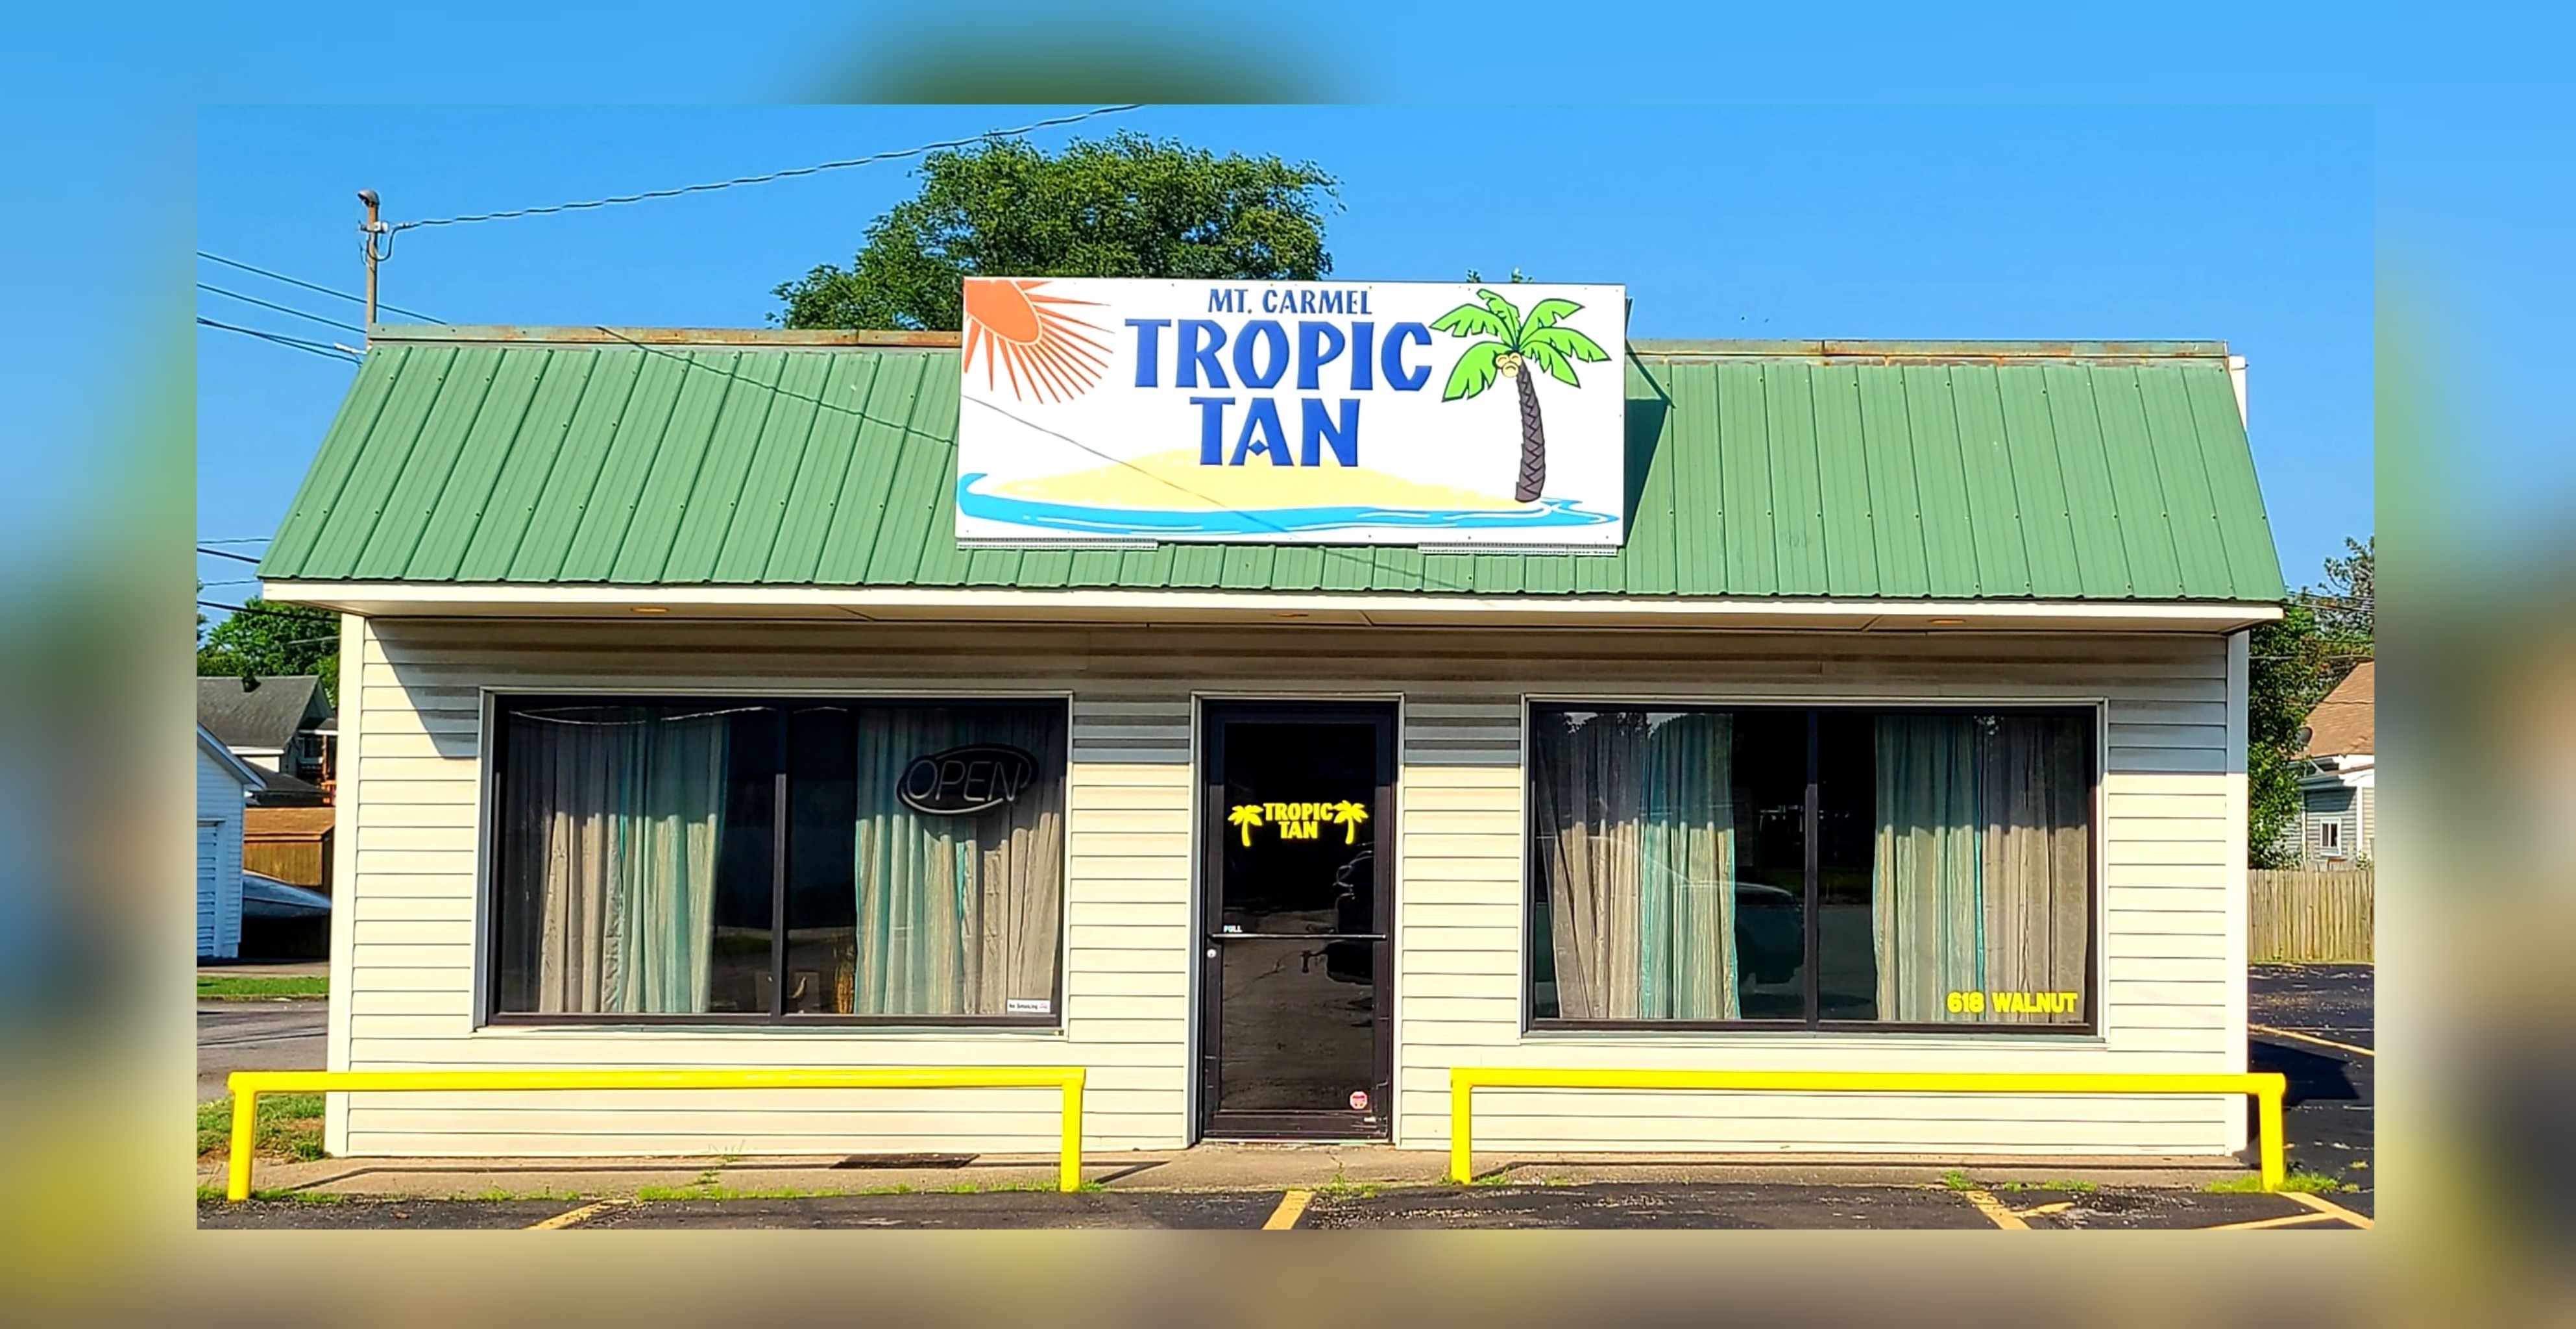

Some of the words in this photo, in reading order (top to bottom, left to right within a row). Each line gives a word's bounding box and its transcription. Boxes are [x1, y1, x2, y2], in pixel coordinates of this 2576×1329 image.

[1208, 289, 1252, 314] MT.
[1262, 289, 1372, 315] CARMEL
[1125, 319, 1432, 391] TROPIC
[1189, 396, 1361, 467] TAN
[906, 759, 1022, 801] OPEN
[1263, 803, 1334, 821] TROPIC
[1278, 821, 1318, 838] TAN
[1947, 992, 1984, 1013] 618
[1992, 992, 2078, 1013] WALNUT
